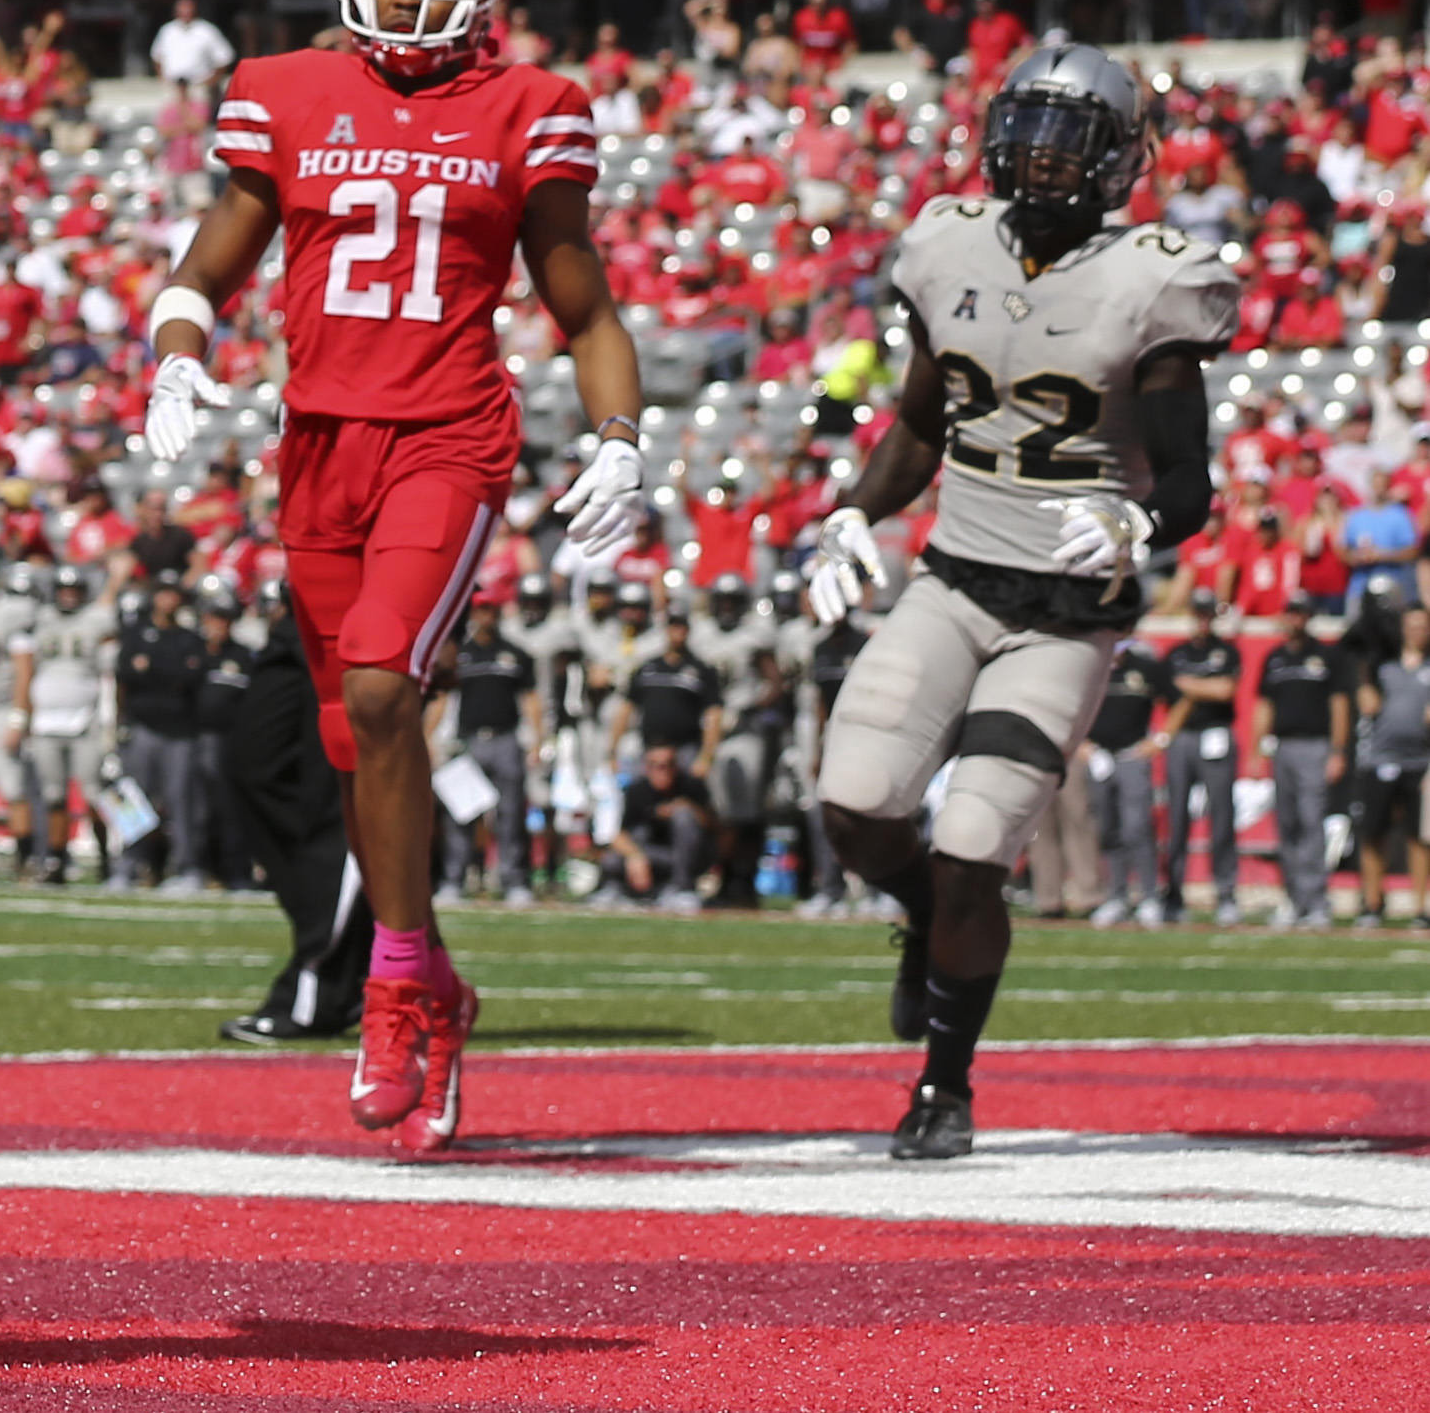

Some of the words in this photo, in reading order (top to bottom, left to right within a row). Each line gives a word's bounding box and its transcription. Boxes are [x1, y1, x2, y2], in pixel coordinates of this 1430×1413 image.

[296, 149, 501, 187] HOUSTON
[323, 178, 448, 323] 21
[939, 350, 1105, 486] 22
